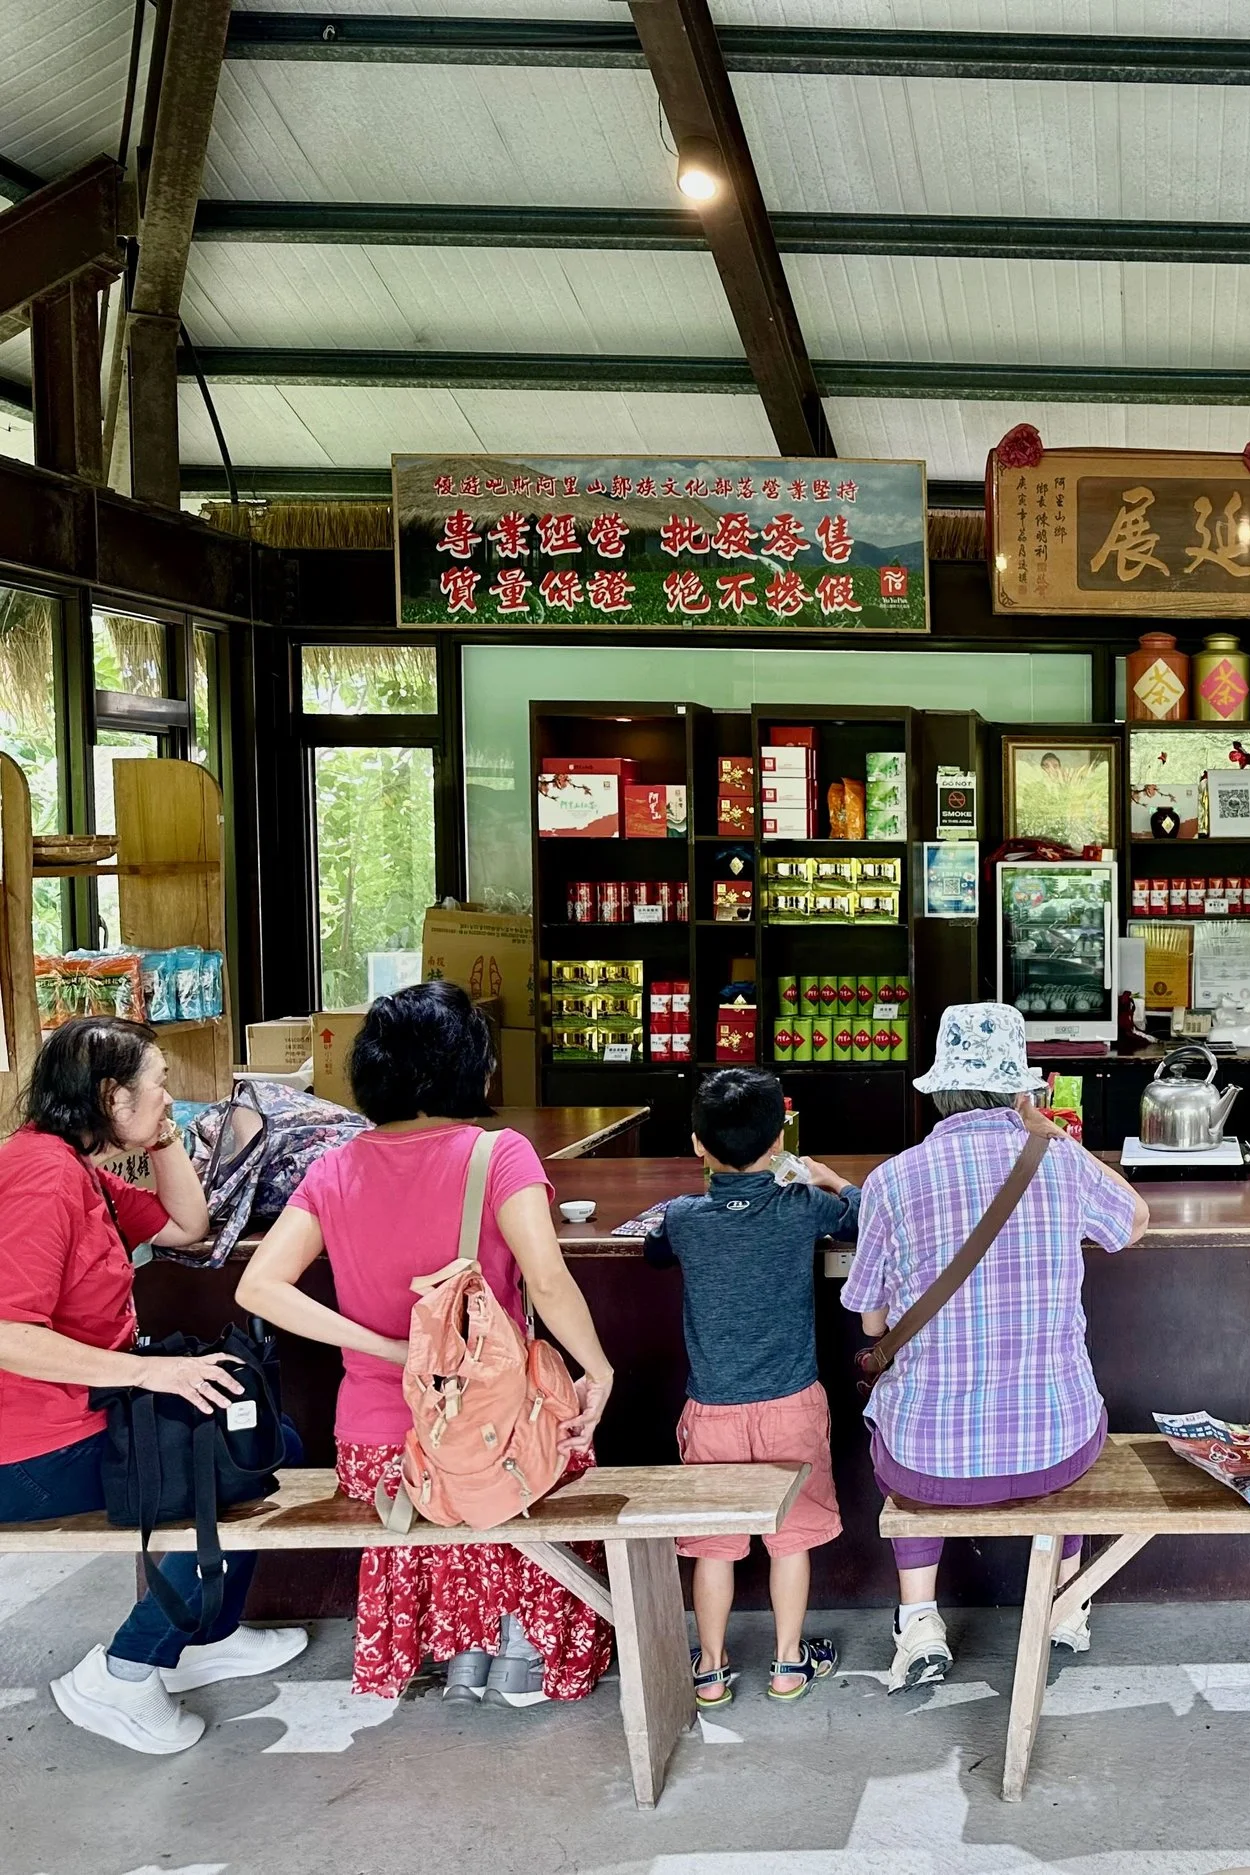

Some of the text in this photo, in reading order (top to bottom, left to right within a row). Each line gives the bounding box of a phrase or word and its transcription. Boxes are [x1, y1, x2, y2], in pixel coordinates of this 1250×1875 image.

[433, 474, 858, 502] 優遊吧斯阿里山鄒族文化部落營業堅持
[436, 510, 856, 564] 專業經營 批發零售
[439, 565, 862, 616] 質量保證 絕不摻假
[1141, 665, 1180, 706] 茶
[1207, 664, 1245, 706] 茶
